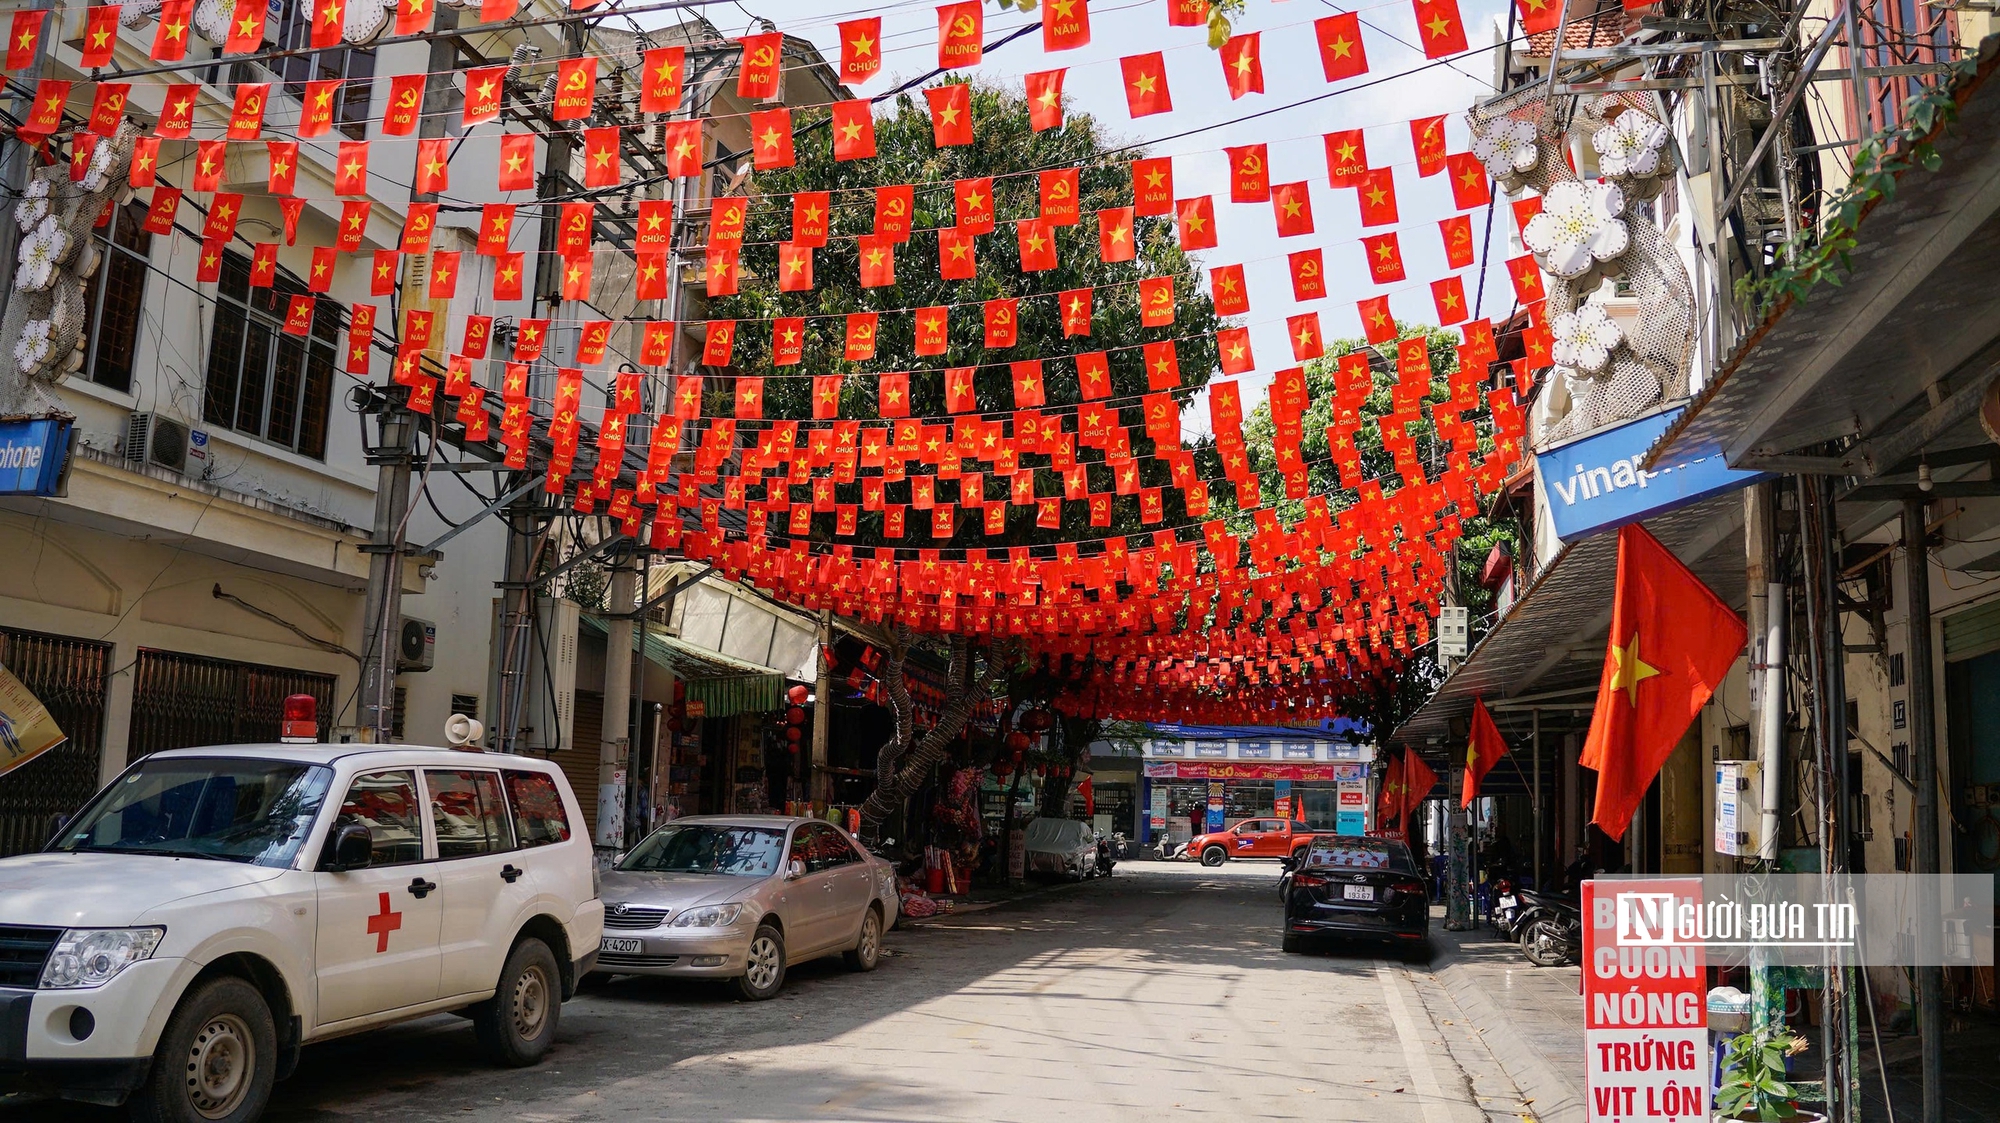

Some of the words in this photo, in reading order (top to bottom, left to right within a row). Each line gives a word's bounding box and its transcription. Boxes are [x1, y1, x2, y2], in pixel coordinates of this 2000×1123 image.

[1054, 22, 1079, 35] NĂM
[946, 42, 978, 54] MỪNG
[849, 58, 879, 73] CHÚC
[559, 98, 586, 106] MỪNG
[472, 102, 497, 115] CHÚC
[235, 120, 257, 129] MỪNG
[1336, 162, 1364, 176] CHÚC
[1144, 191, 1168, 203] NĂM
[1046, 204, 1074, 215] MỪNG
[964, 213, 990, 224] CHÚC
[641, 232, 665, 243] CHÚC
[716, 229, 742, 240] MỪNG
[1377, 261, 1400, 273] CHÚC
[1149, 306, 1172, 316] MỪNG
[1405, 362, 1427, 372] MỪNG
[1594, 986, 1699, 1025] NÓNG
[1597, 1034, 1696, 1072] TRỨNG
[1594, 1087, 1637, 1123] VỊT
[1646, 1080, 1702, 1123] LỘN
